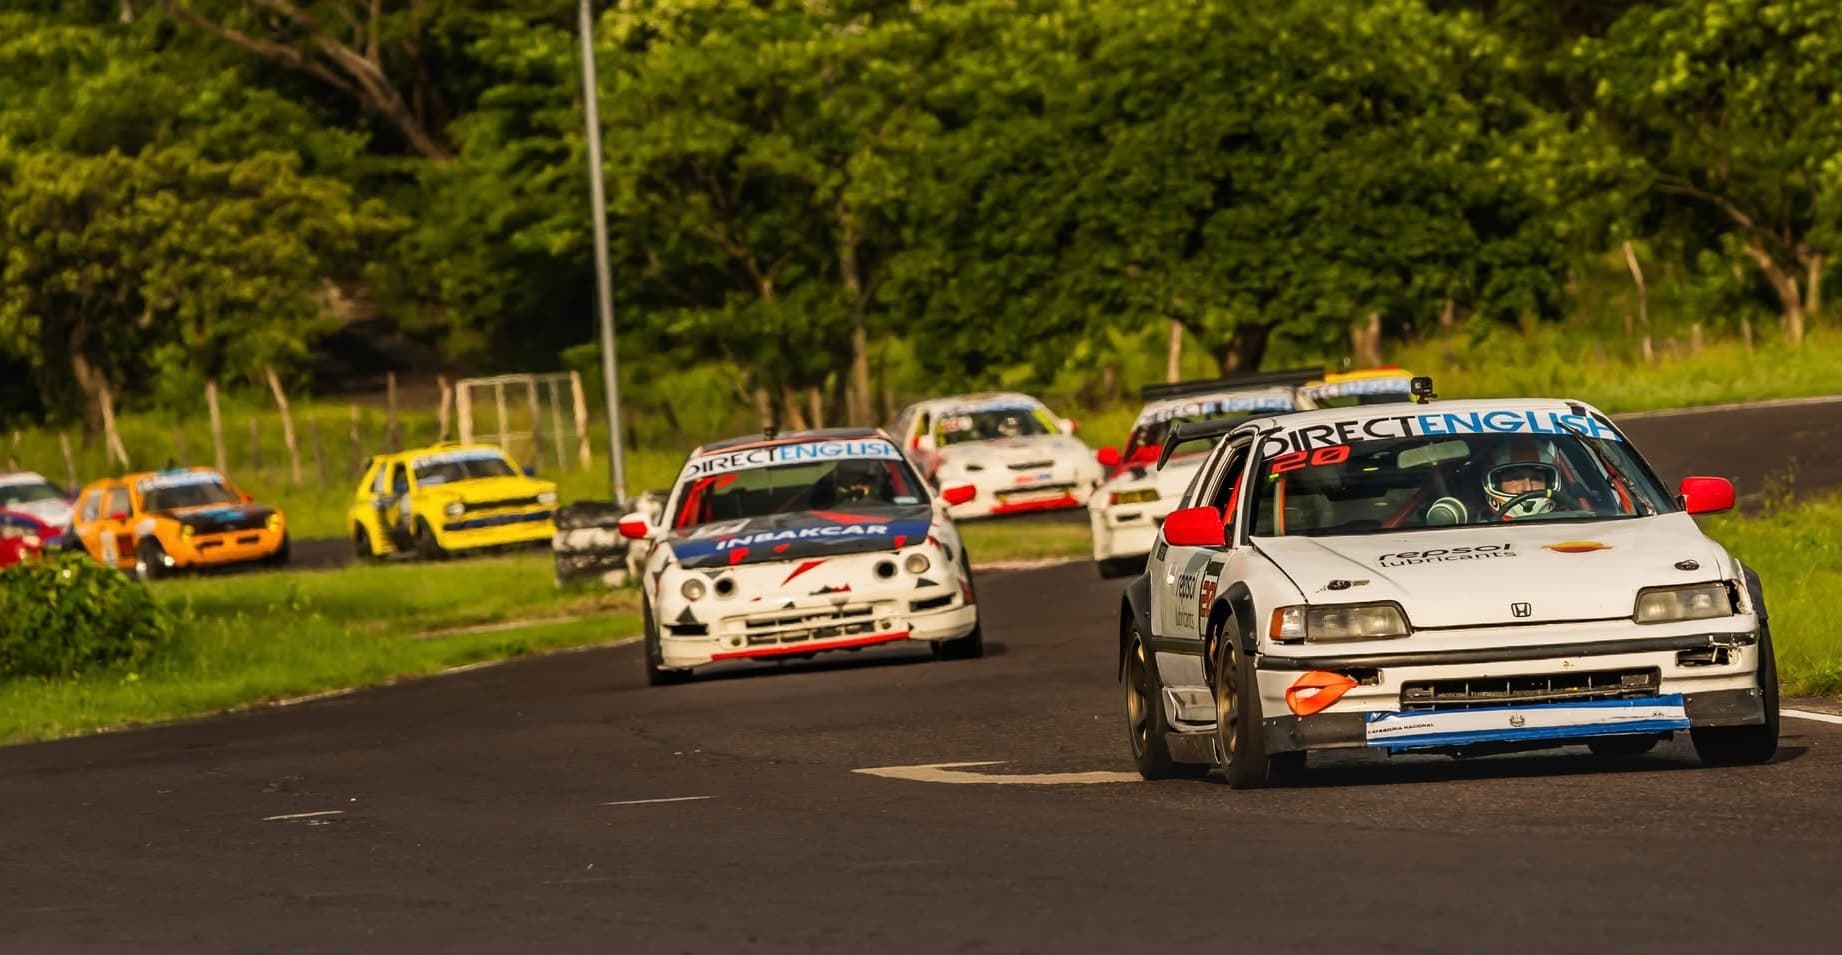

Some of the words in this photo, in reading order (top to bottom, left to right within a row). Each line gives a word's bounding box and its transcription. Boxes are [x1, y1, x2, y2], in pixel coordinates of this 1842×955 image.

[1271, 443, 1350, 473] 20
[715, 525, 888, 550] INBAKCAR
[1379, 543, 1511, 561] repsol
[1380, 551, 1517, 568] lubricants
[1175, 571, 1200, 604] repsol
